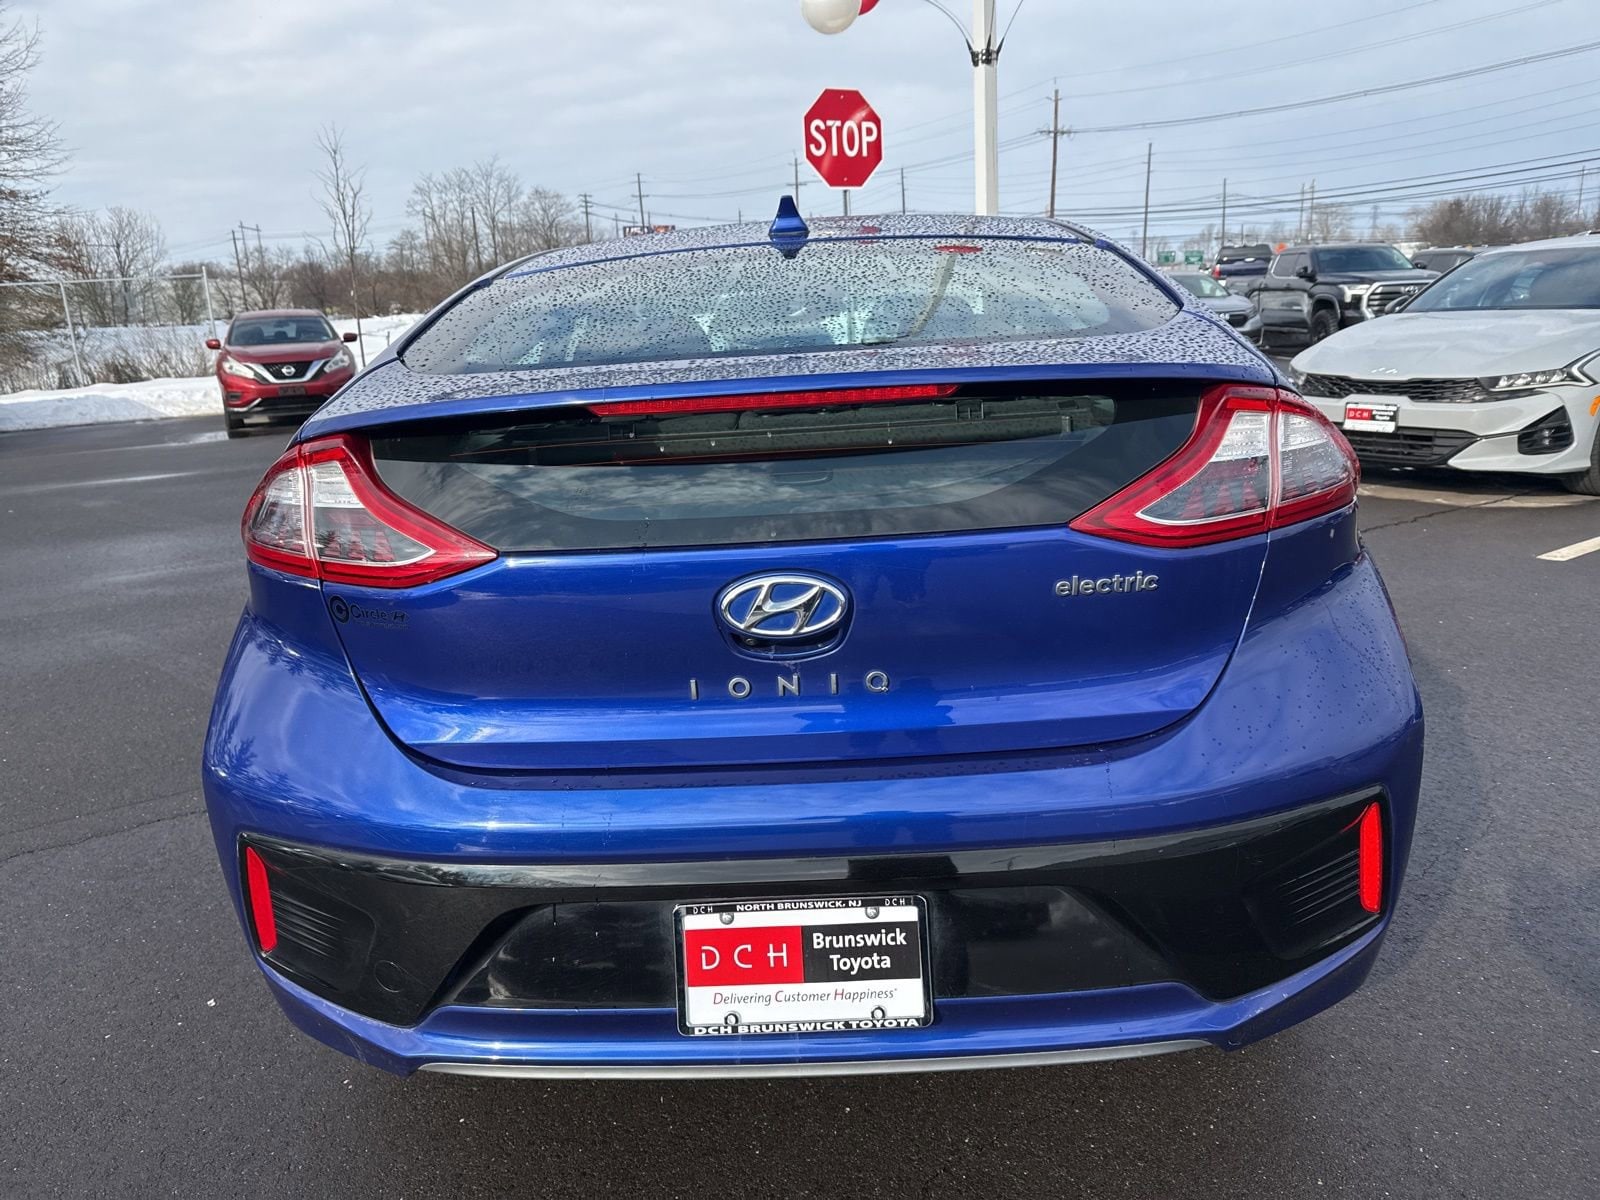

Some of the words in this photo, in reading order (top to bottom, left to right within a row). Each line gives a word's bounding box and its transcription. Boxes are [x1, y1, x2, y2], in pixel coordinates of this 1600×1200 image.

[809, 118, 878, 158] STOP
[1055, 570, 1159, 597] electric
[350, 604, 387, 620] Circle
[689, 669, 890, 700] IONIQ
[692, 906, 713, 914] DCH
[736, 903, 775, 911] NORTH
[848, 899, 862, 907] NJ
[884, 898, 905, 906] DCH
[812, 928, 907, 949] Brunswick
[701, 943, 788, 970] DCH
[829, 954, 891, 975] Toyota
[713, 992, 771, 1006] Delivering
[774, 990, 831, 1003] Customer
[694, 1026, 732, 1035] DCH
[738, 1020, 846, 1033] BRUNSWICK
[849, 1018, 920, 1029] TOYOTA
